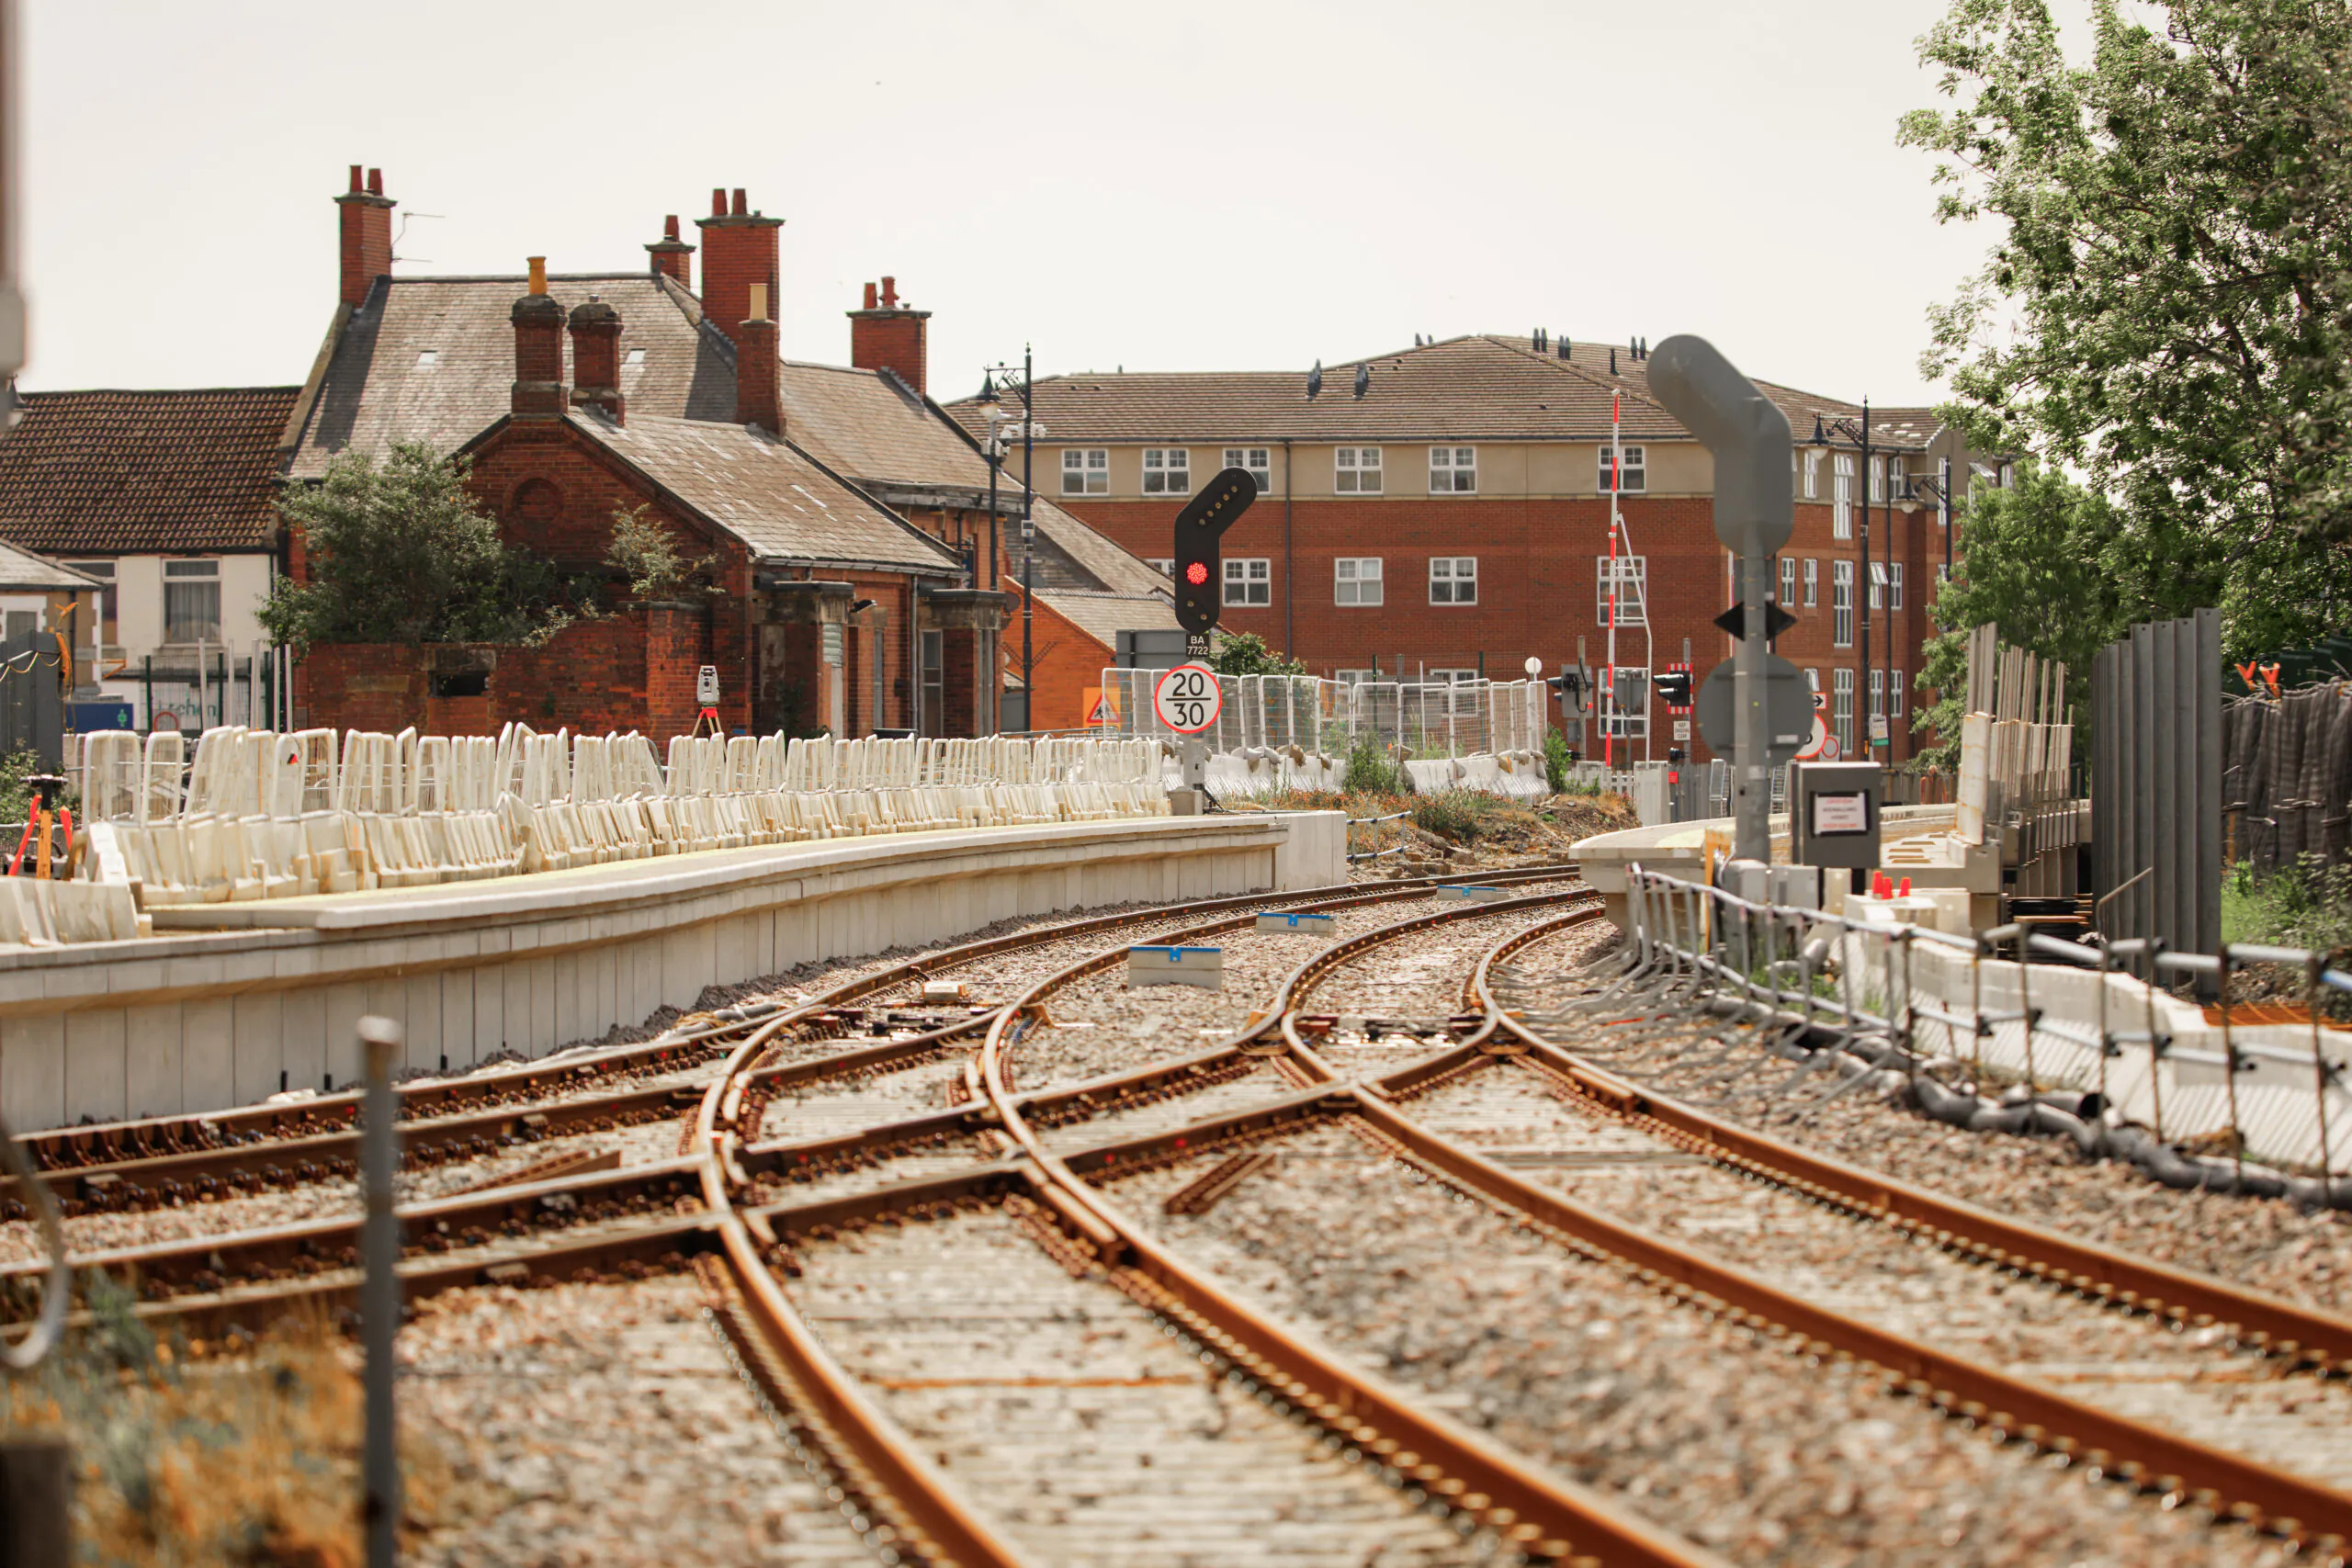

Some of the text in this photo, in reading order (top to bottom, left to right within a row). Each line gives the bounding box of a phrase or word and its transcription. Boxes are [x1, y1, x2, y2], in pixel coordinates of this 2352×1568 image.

[1191, 636, 1204, 645] BA
[1187, 646, 1209, 655] 7722
[1172, 672, 1204, 696] 20
[1173, 702, 1204, 727] 30
